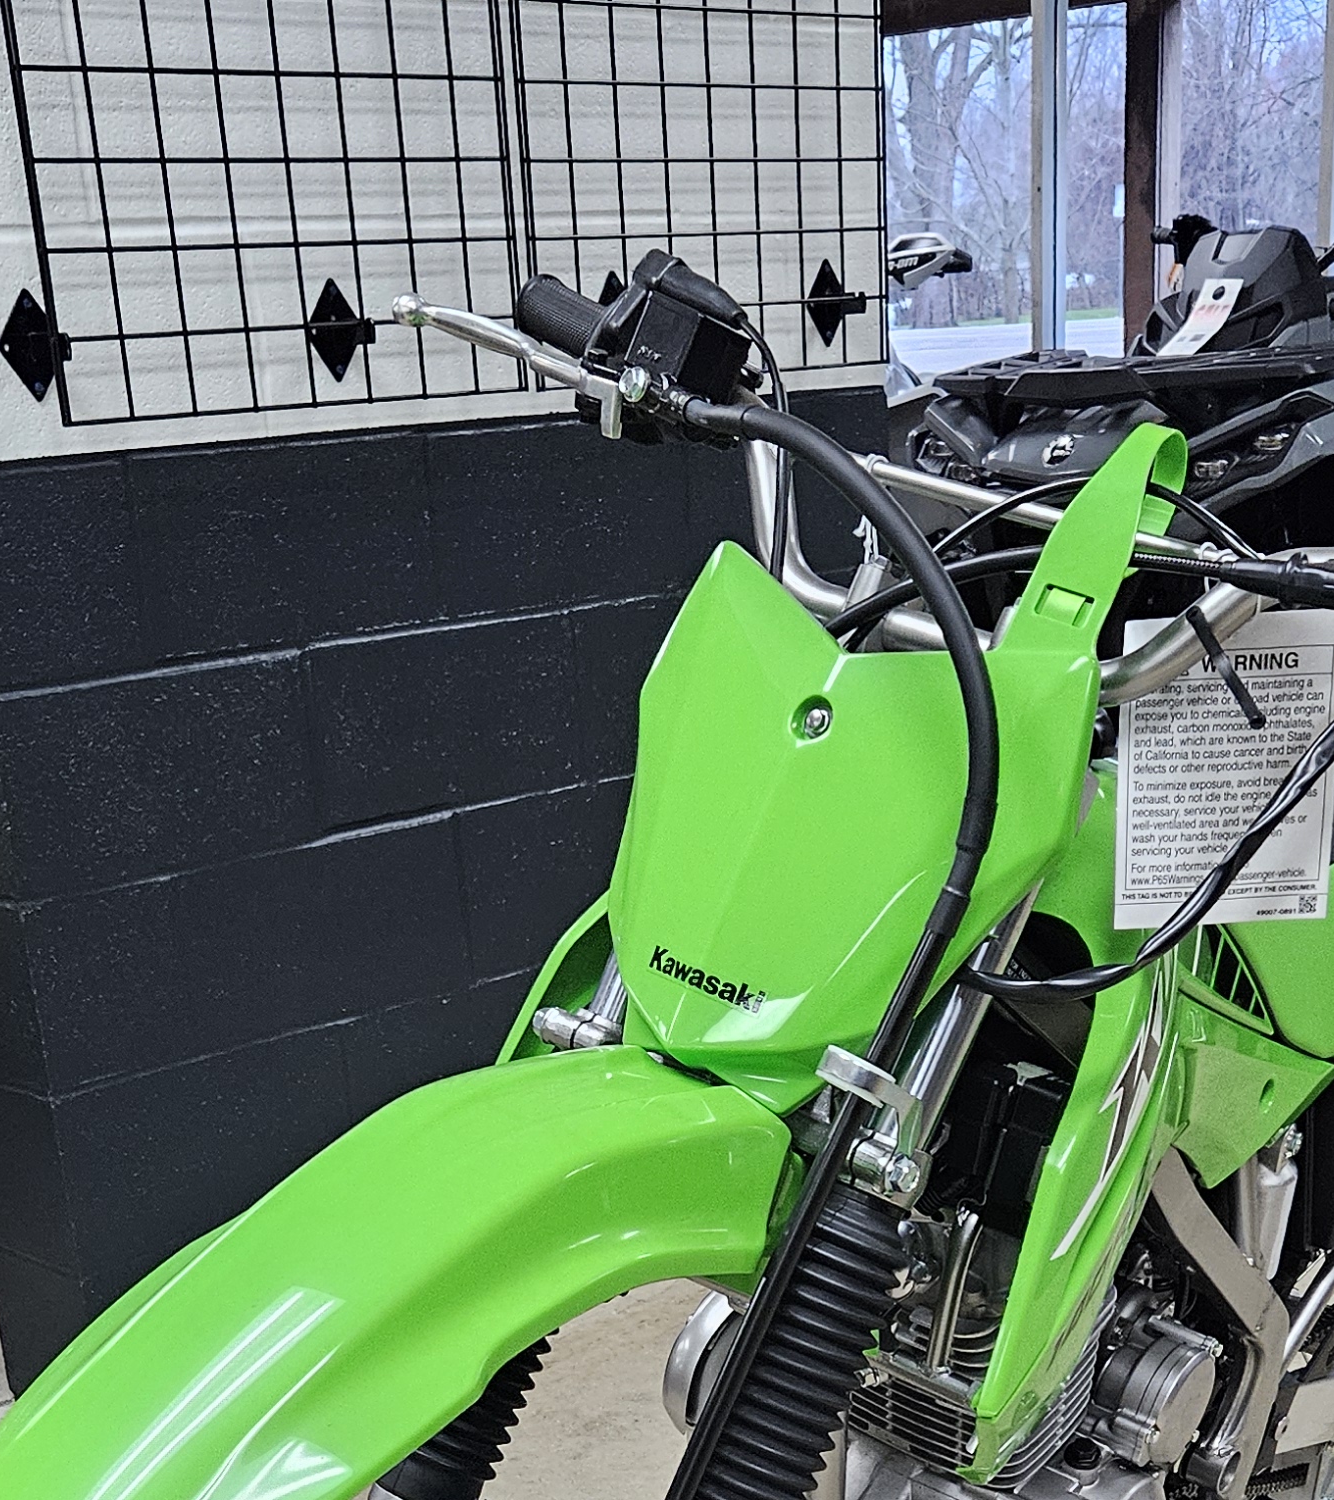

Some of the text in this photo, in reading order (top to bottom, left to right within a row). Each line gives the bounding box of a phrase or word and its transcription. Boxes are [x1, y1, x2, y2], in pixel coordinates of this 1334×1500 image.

[1202, 652, 1299, 673] WRNING
[1187, 681, 1228, 694] servicing
[1251, 678, 1305, 691] maintaining
[1306, 679, 1313, 688] a
[1135, 697, 1184, 710] passenger
[1187, 694, 1219, 706] vehicle
[1221, 697, 1231, 705] or
[1272, 690, 1304, 702] vehicle
[1306, 691, 1324, 701] can
[1135, 711, 1168, 722] expose
[1171, 711, 1187, 723] you
[1190, 709, 1199, 719] to
[1294, 704, 1325, 717] engine
[1134, 724, 1174, 735] exhaust,
[1177, 723, 1209, 733] carbon
[1134, 730, 1312, 748] and lead, which are known to the State
[1134, 750, 1142, 761] of
[1145, 749, 1188, 761] California
[1191, 750, 1200, 760] to
[1202, 750, 1231, 760] cause
[1233, 748, 1265, 758] cancer
[1266, 745, 1284, 756] and
[1133, 758, 1292, 774] defects or other reproductive harm.
[1133, 780, 1144, 791] To
[1146, 780, 1186, 791] minimize
[1189, 779, 1234, 791] exposure,
[1236, 776, 1261, 788] avoid
[1132, 794, 1171, 805] exhaust,
[1173, 793, 1185, 804] do
[1187, 793, 1202, 803] not
[1205, 791, 1221, 802] idle
[1223, 791, 1238, 801] the
[1240, 789, 1271, 803] engine
[1132, 807, 1181, 819] necessary,
[1183, 805, 1216, 816] service
[1219, 805, 1239, 817] your
[1132, 818, 1197, 831] well-ventilated
[1198, 819, 1219, 828] area
[1222, 817, 1240, 828] and
[1297, 815, 1307, 823] or
[1131, 833, 1155, 844] wash
[1158, 833, 1178, 846] your
[1180, 831, 1208, 842] hands
[1131, 846, 1172, 858] servicing
[1174, 846, 1195, 858] your
[1131, 863, 1146, 873] For
[1148, 864, 1172, 873] more
[1137, 892, 1150, 900] TAG
[1159, 891, 1172, 899] NOT
[1173, 891, 1182, 899] TO
[1228, 887, 1253, 896] EXCEPT
[1264, 885, 1277, 893] THE
[1278, 883, 1317, 893] CONSUMER.
[648, 944, 766, 1014] Kawasaki
